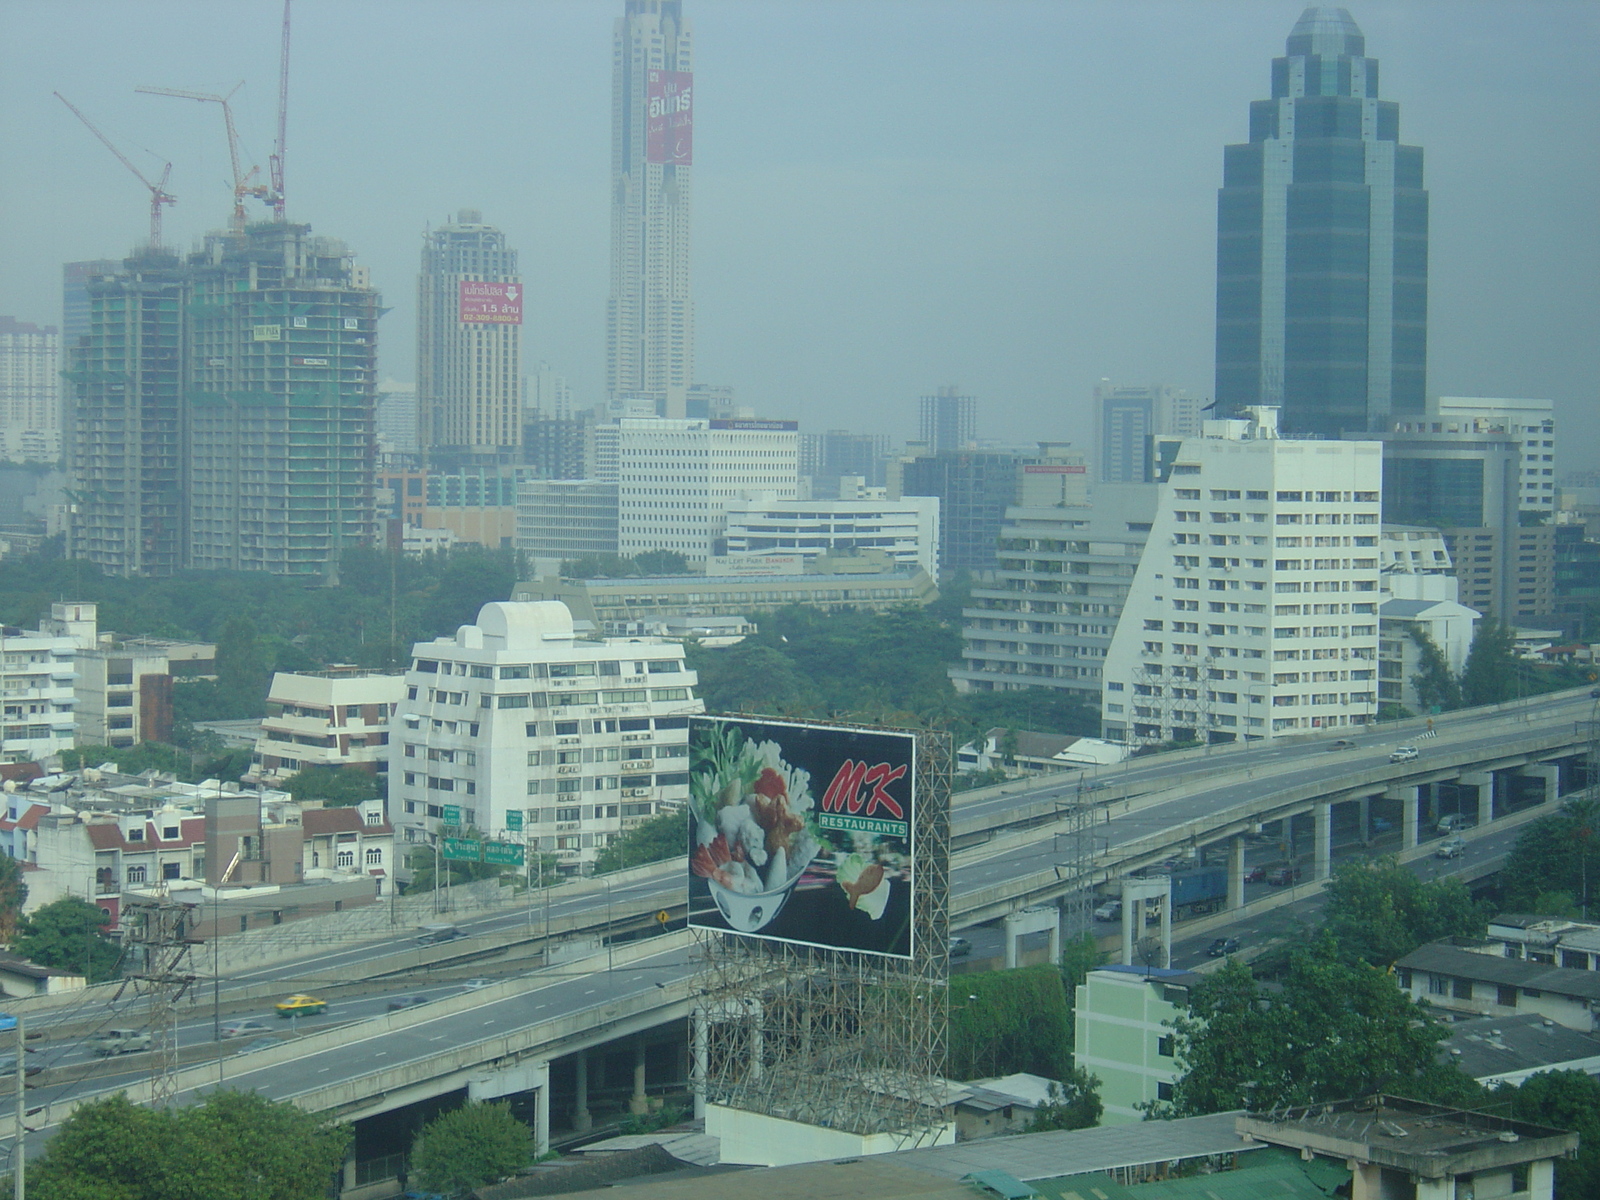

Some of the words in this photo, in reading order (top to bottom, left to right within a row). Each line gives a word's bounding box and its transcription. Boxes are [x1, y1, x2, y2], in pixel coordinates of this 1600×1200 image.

[482, 304, 497, 313] 1.5
[502, 304, 519, 314] ล้าน
[822, 758, 908, 818] MK
[821, 816, 907, 835] RESTAURANTS
